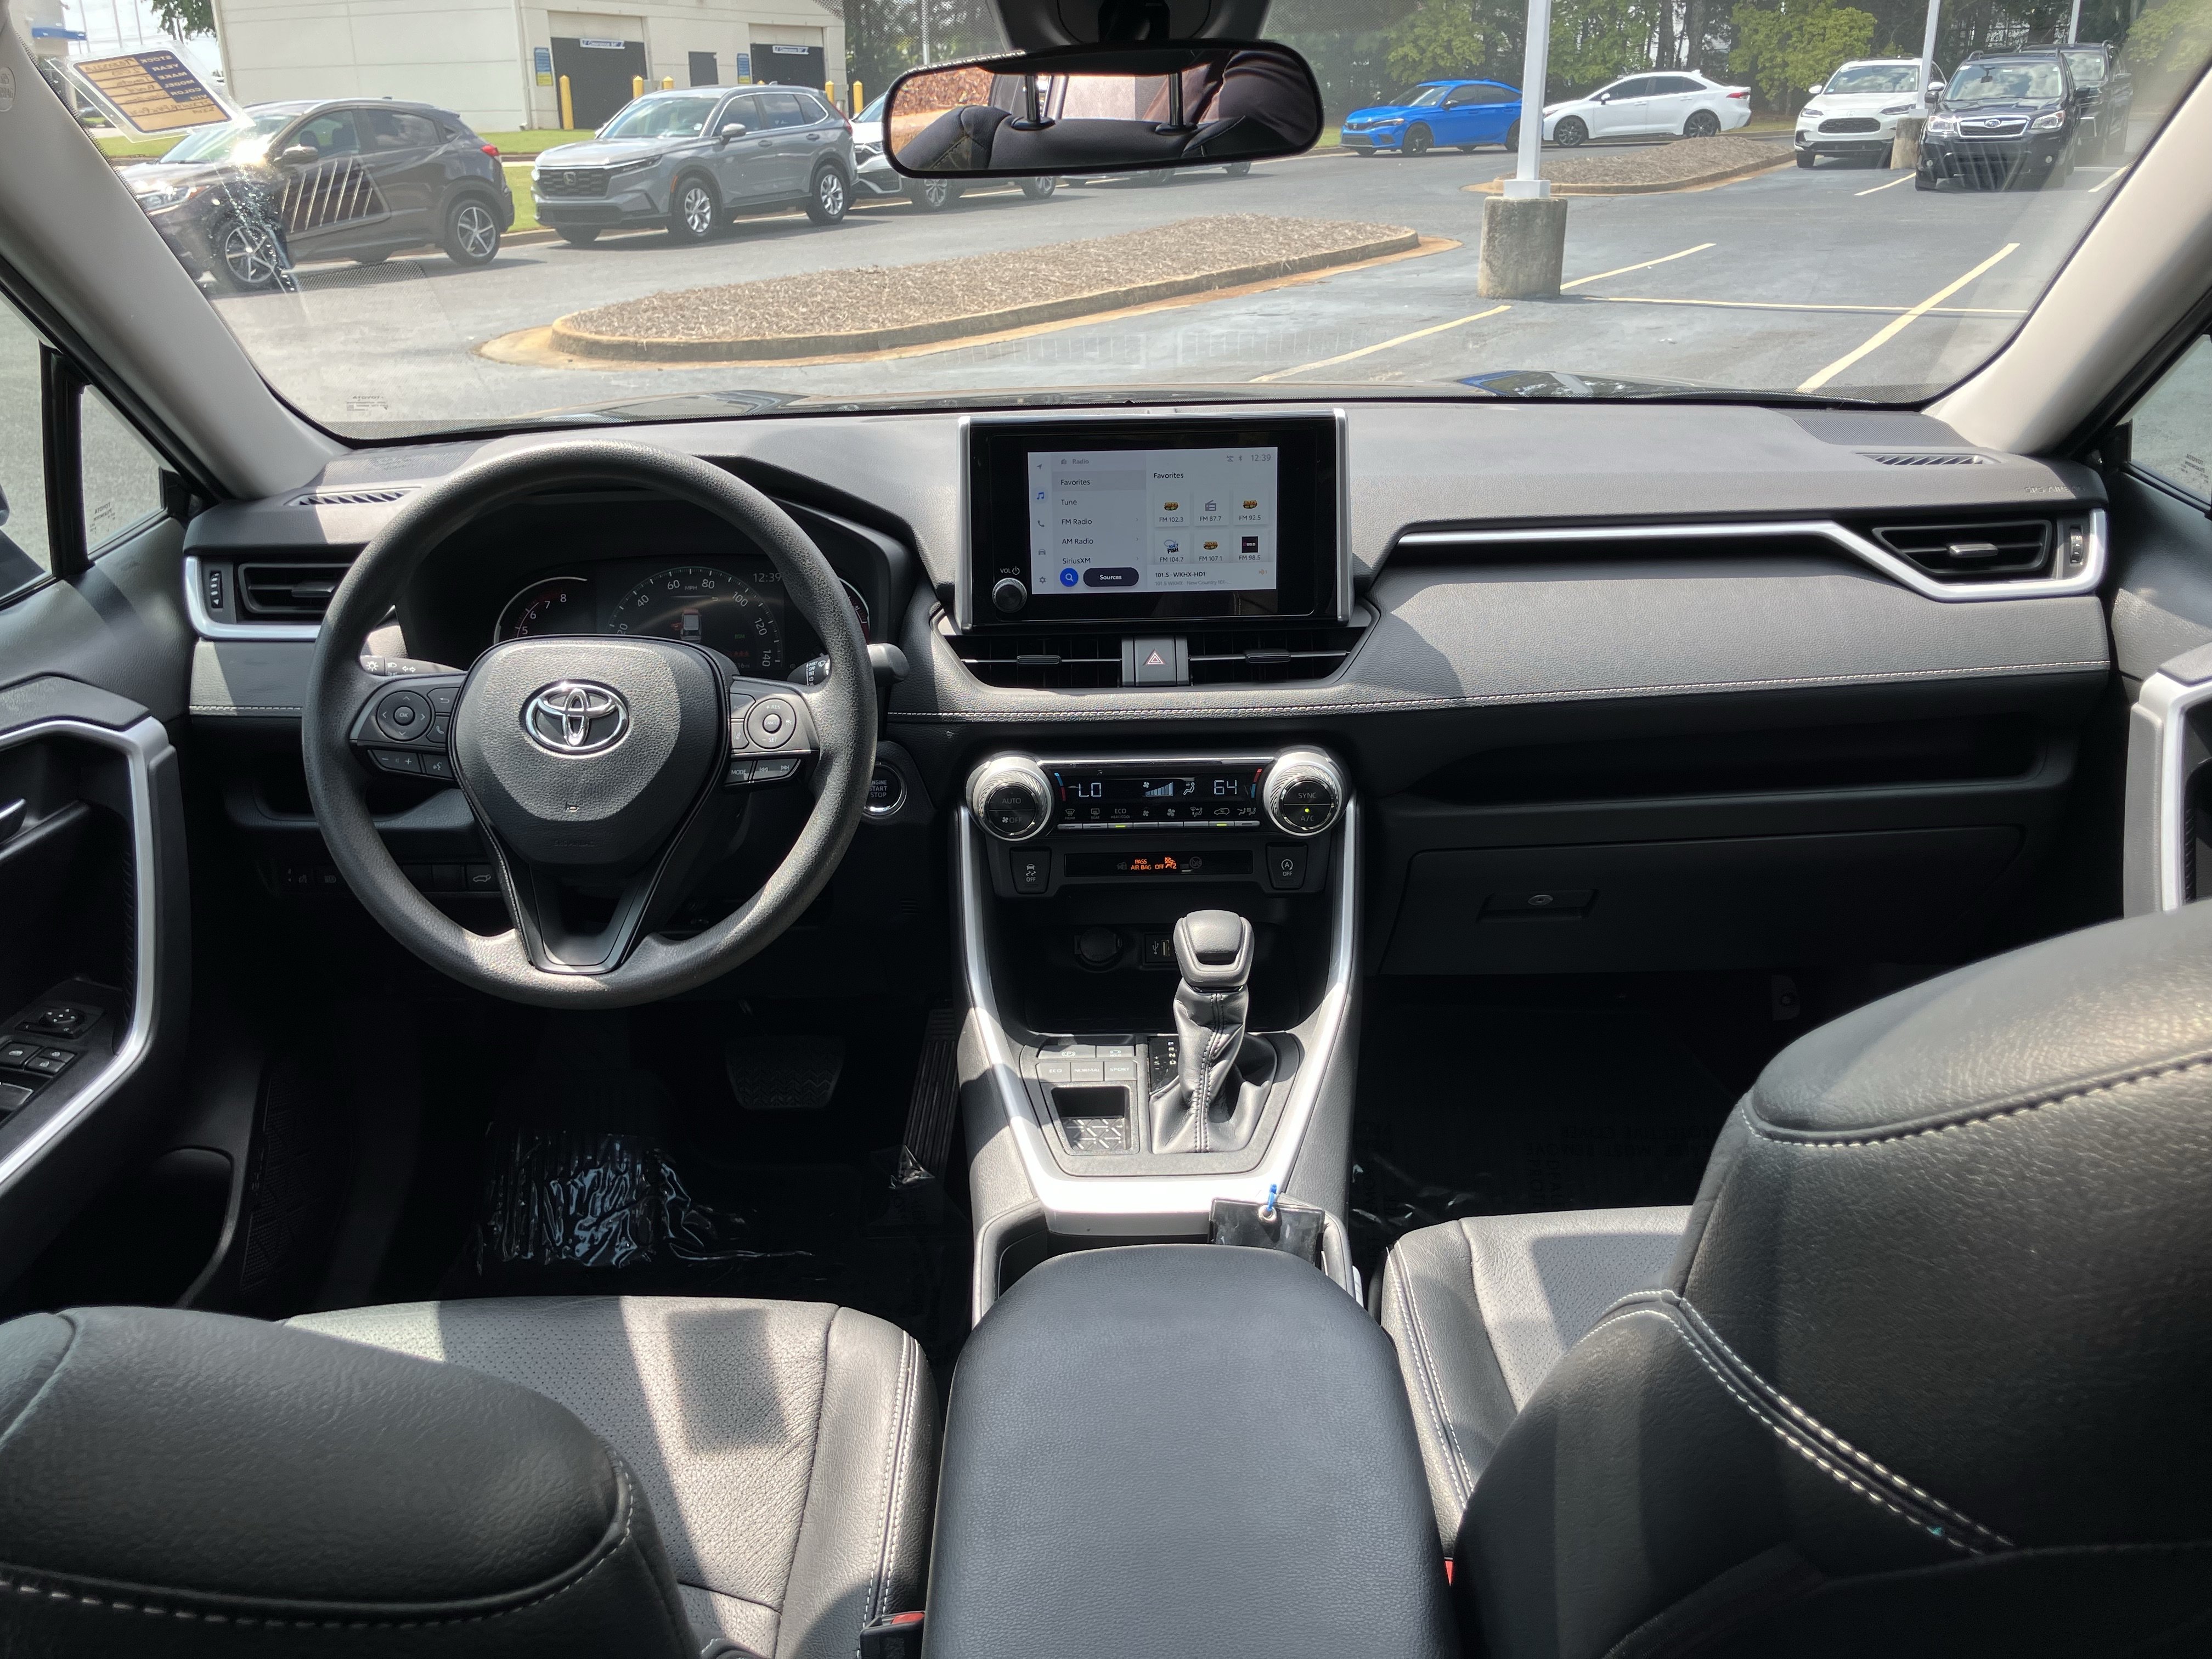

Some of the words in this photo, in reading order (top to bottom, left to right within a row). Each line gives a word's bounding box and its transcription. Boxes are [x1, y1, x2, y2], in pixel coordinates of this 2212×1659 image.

[753, 573, 781, 583] 12:39
[667, 579, 680, 590] 60
[702, 579, 715, 589] 80
[560, 594, 567, 603] 8
[637, 595, 649, 607] 40
[732, 591, 748, 607] 100
[544, 601, 551, 609] 7
[530, 611, 537, 619] 6
[522, 626, 528, 635] 5
[617, 623, 628, 635] 20
[754, 618, 768, 636] 120
[762, 650, 771, 668] 140
[1079, 782, 1102, 797] LO
[1214, 780, 1237, 795] 64
